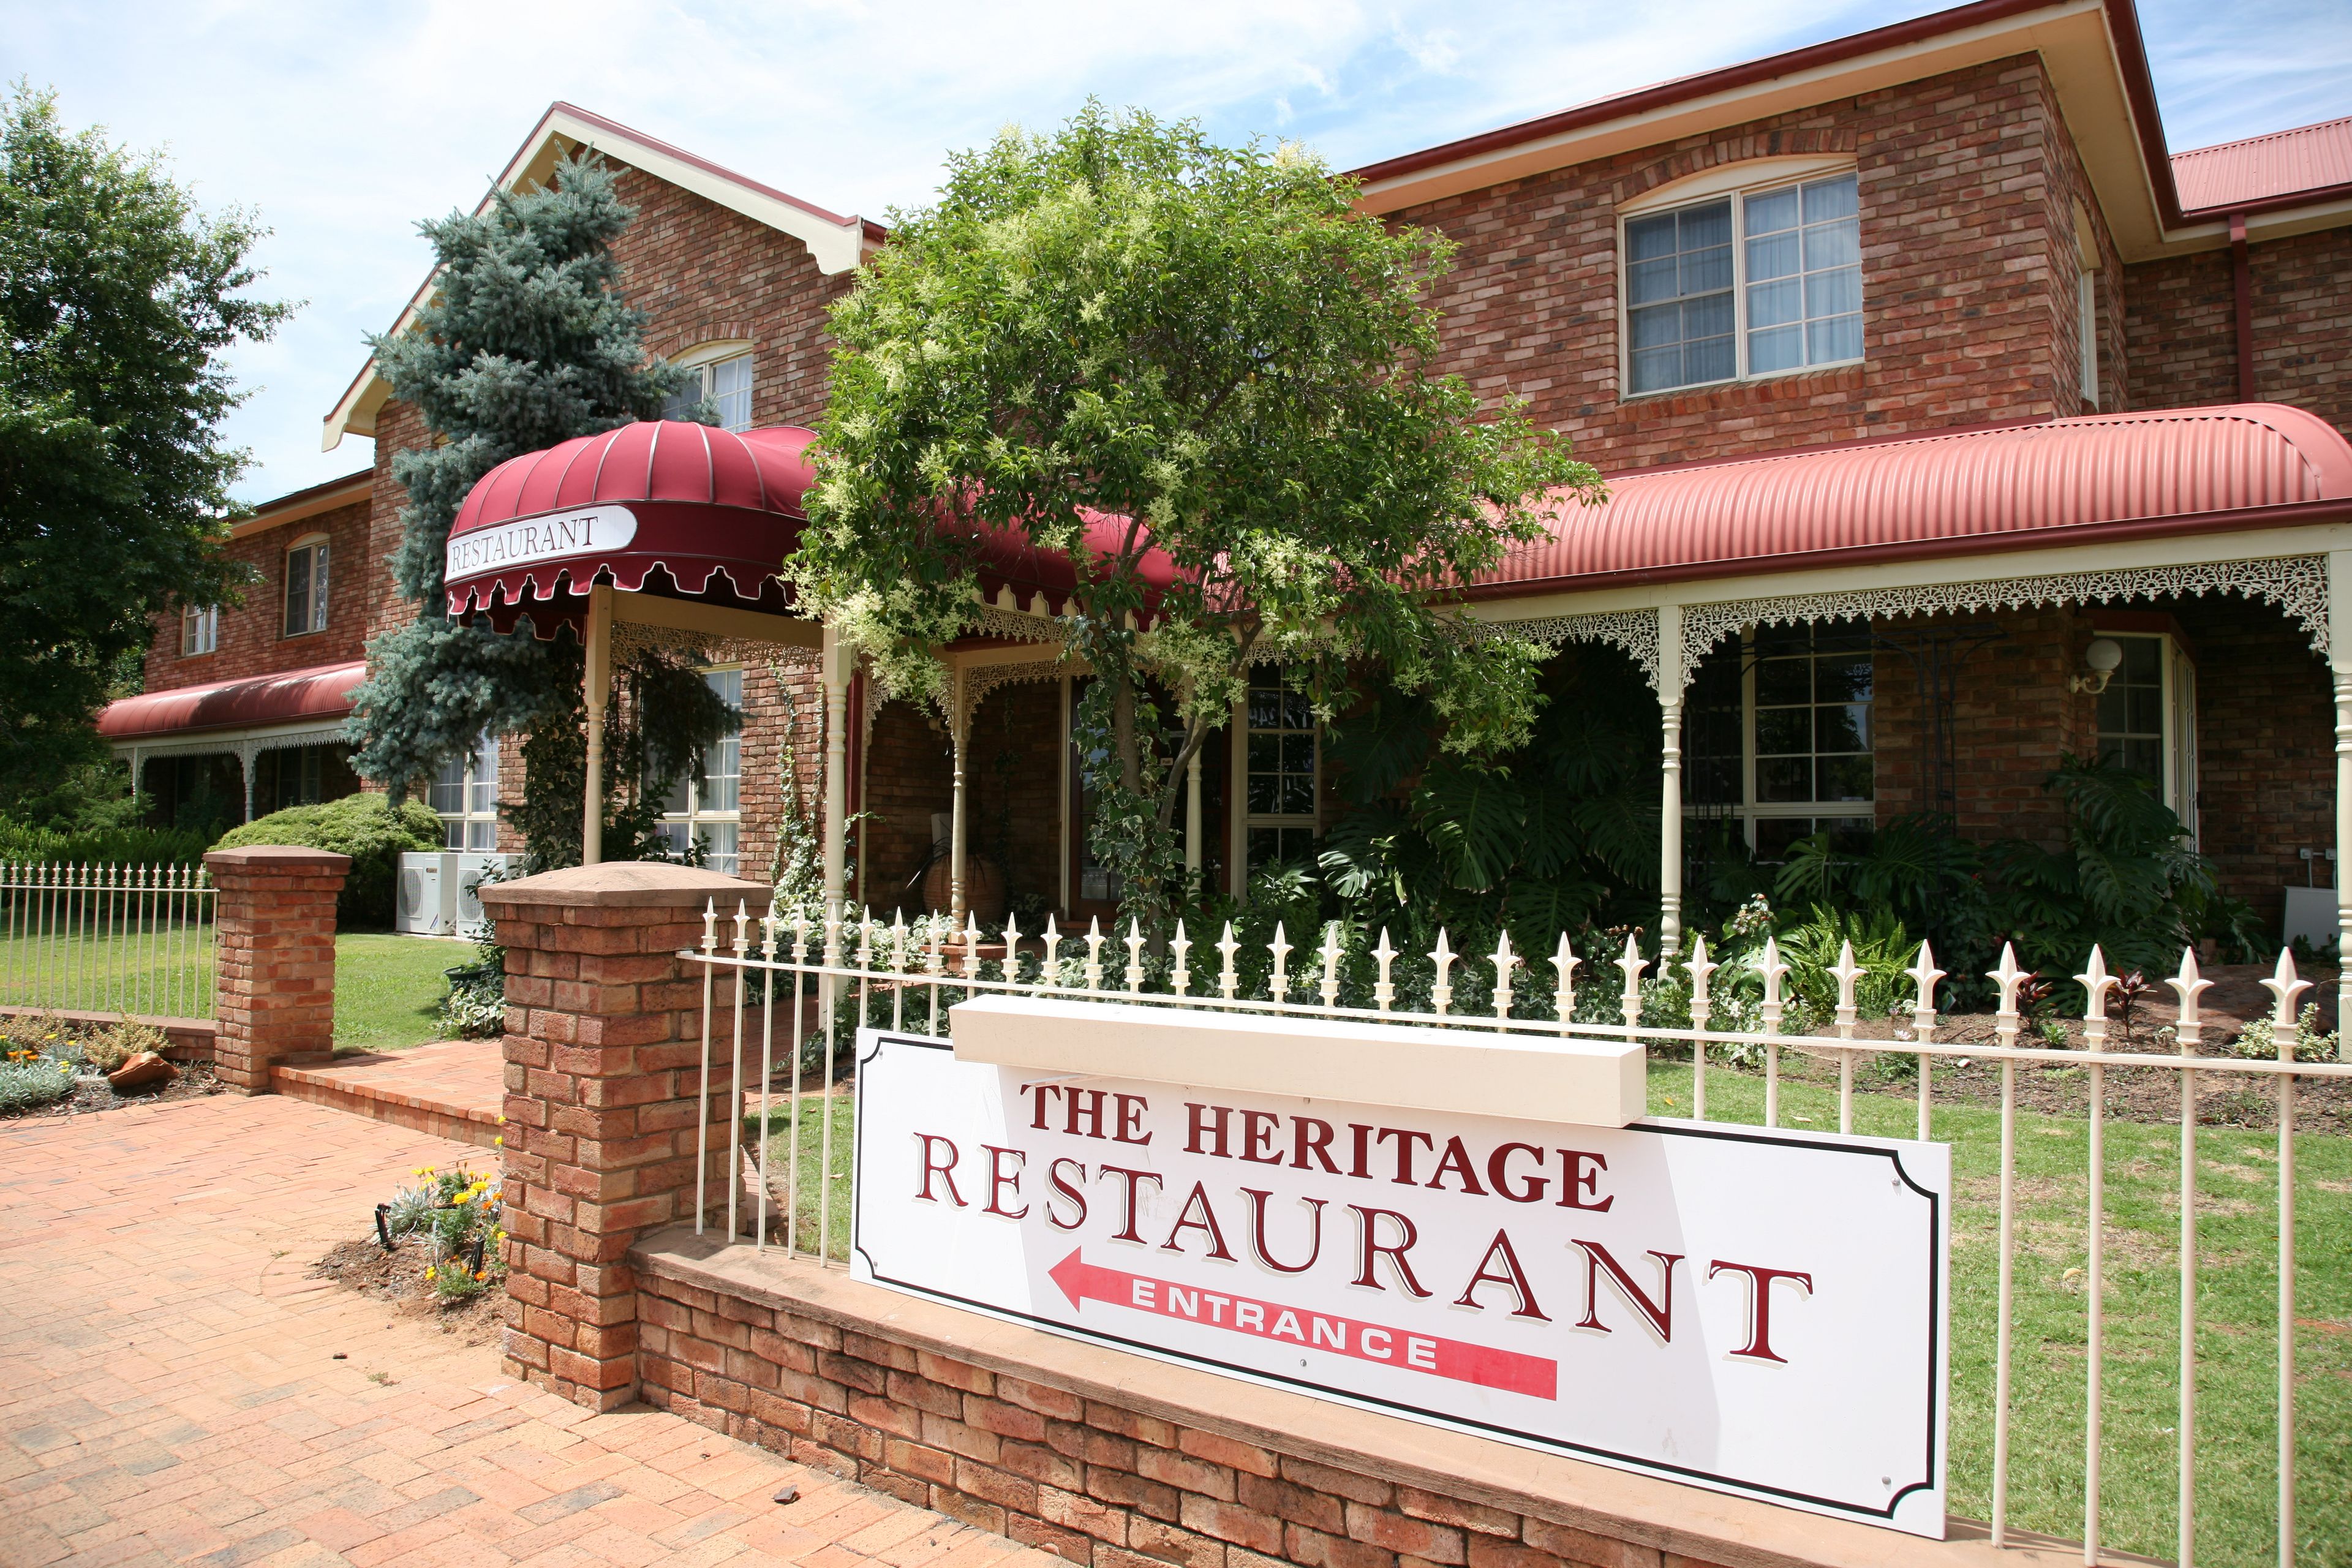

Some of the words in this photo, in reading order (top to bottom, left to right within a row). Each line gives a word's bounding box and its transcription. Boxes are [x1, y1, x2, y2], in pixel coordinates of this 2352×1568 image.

[451, 516, 598, 572] RESTAURANT
[1020, 1084, 1153, 1145] THE
[1183, 1102, 1614, 1212] HERITAGE
[911, 1132, 1813, 1366] RESTAURANT
[1132, 1279, 1437, 1370] ENTRANCE
